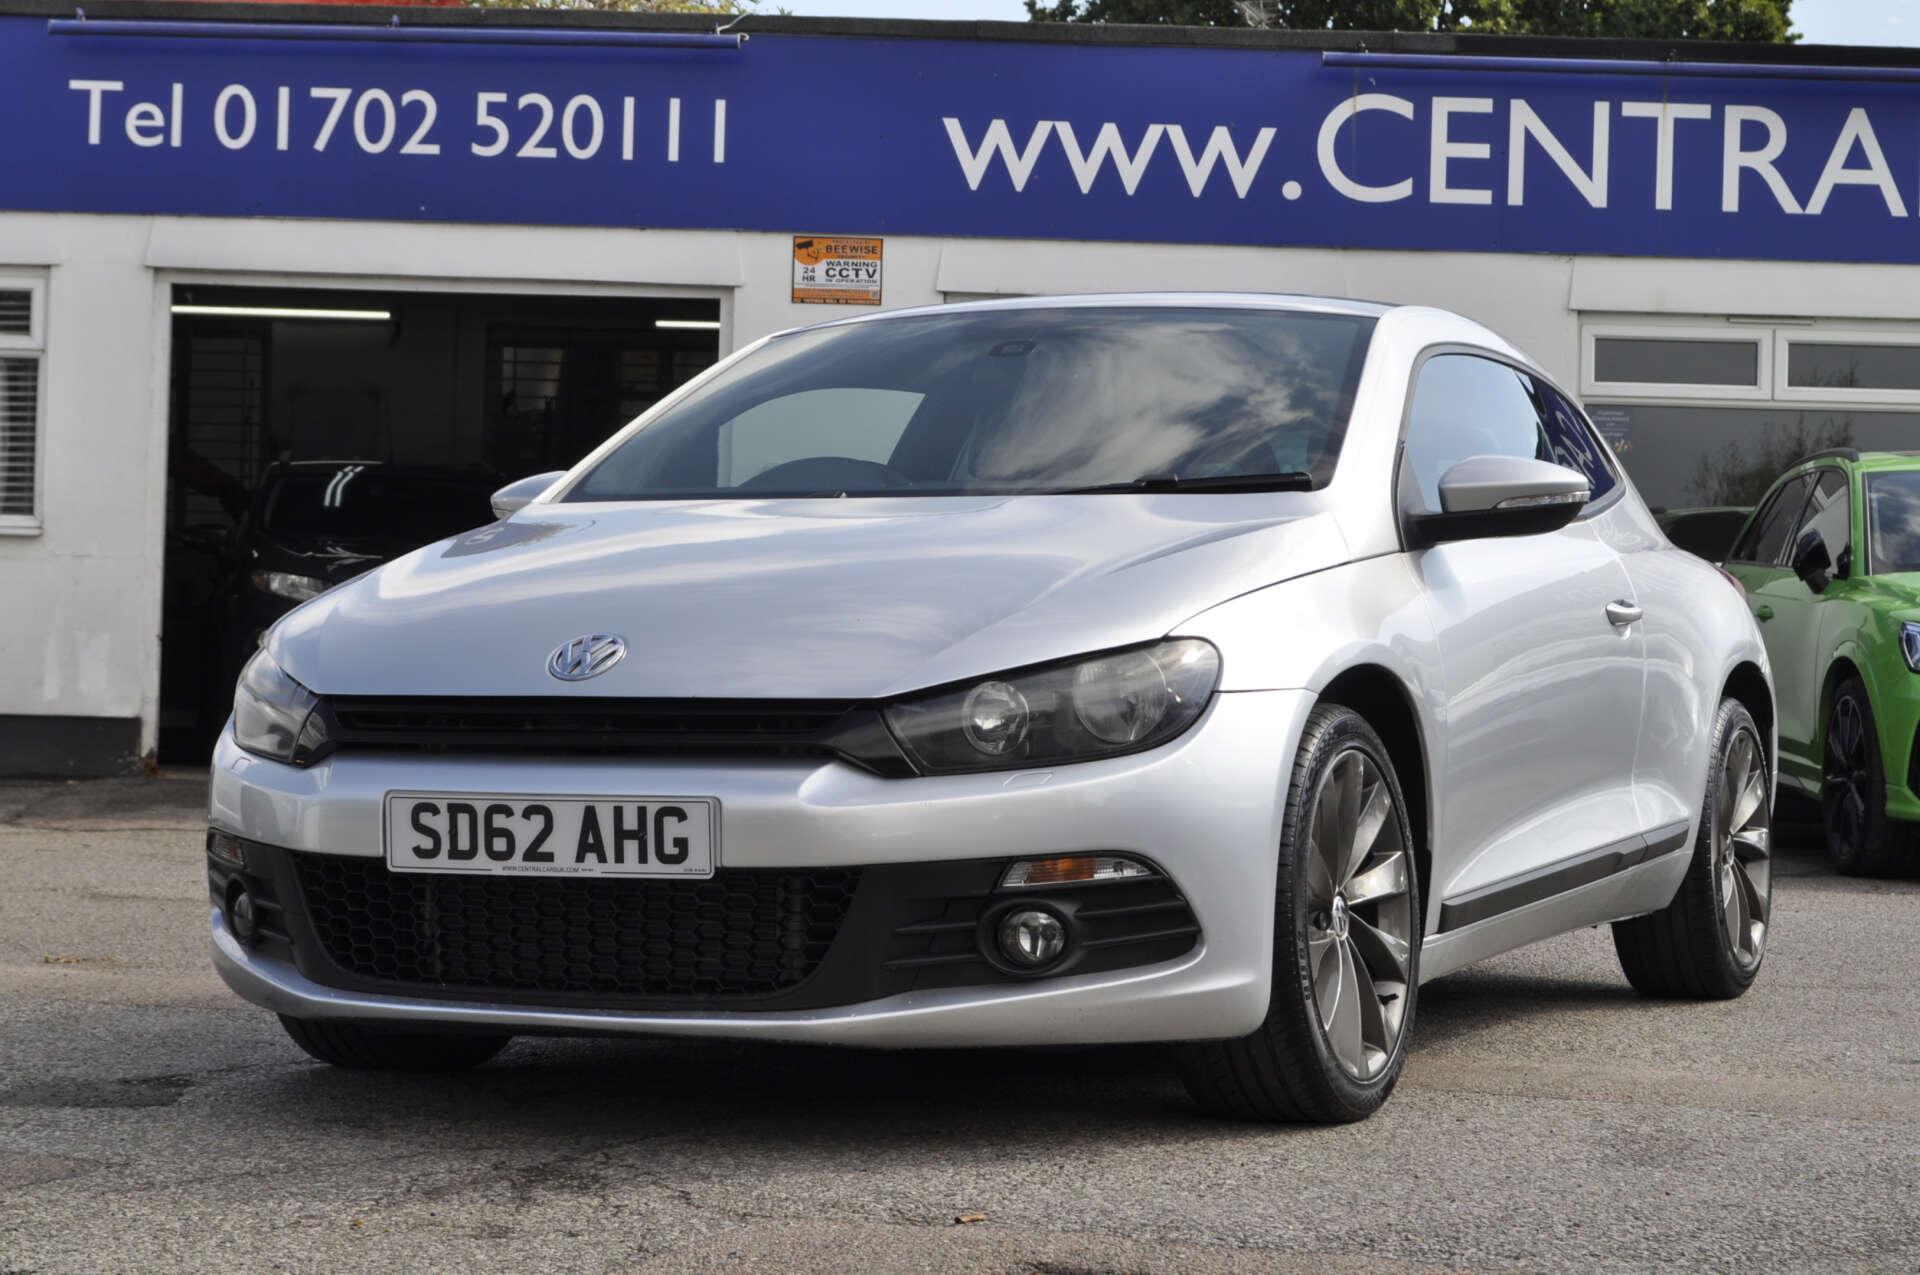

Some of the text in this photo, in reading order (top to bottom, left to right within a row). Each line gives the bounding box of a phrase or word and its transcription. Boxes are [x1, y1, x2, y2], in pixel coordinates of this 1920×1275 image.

[69, 79, 726, 163] Tel 01702 520111
[942, 93, 1920, 217] www.CENTRA
[825, 244, 879, 255] BEEWISE
[826, 260, 878, 268] WARNING
[803, 266, 816, 274] 24
[825, 267, 877, 279] CCTV
[802, 274, 816, 282] HR
[410, 801, 689, 865] SD62 AHG
